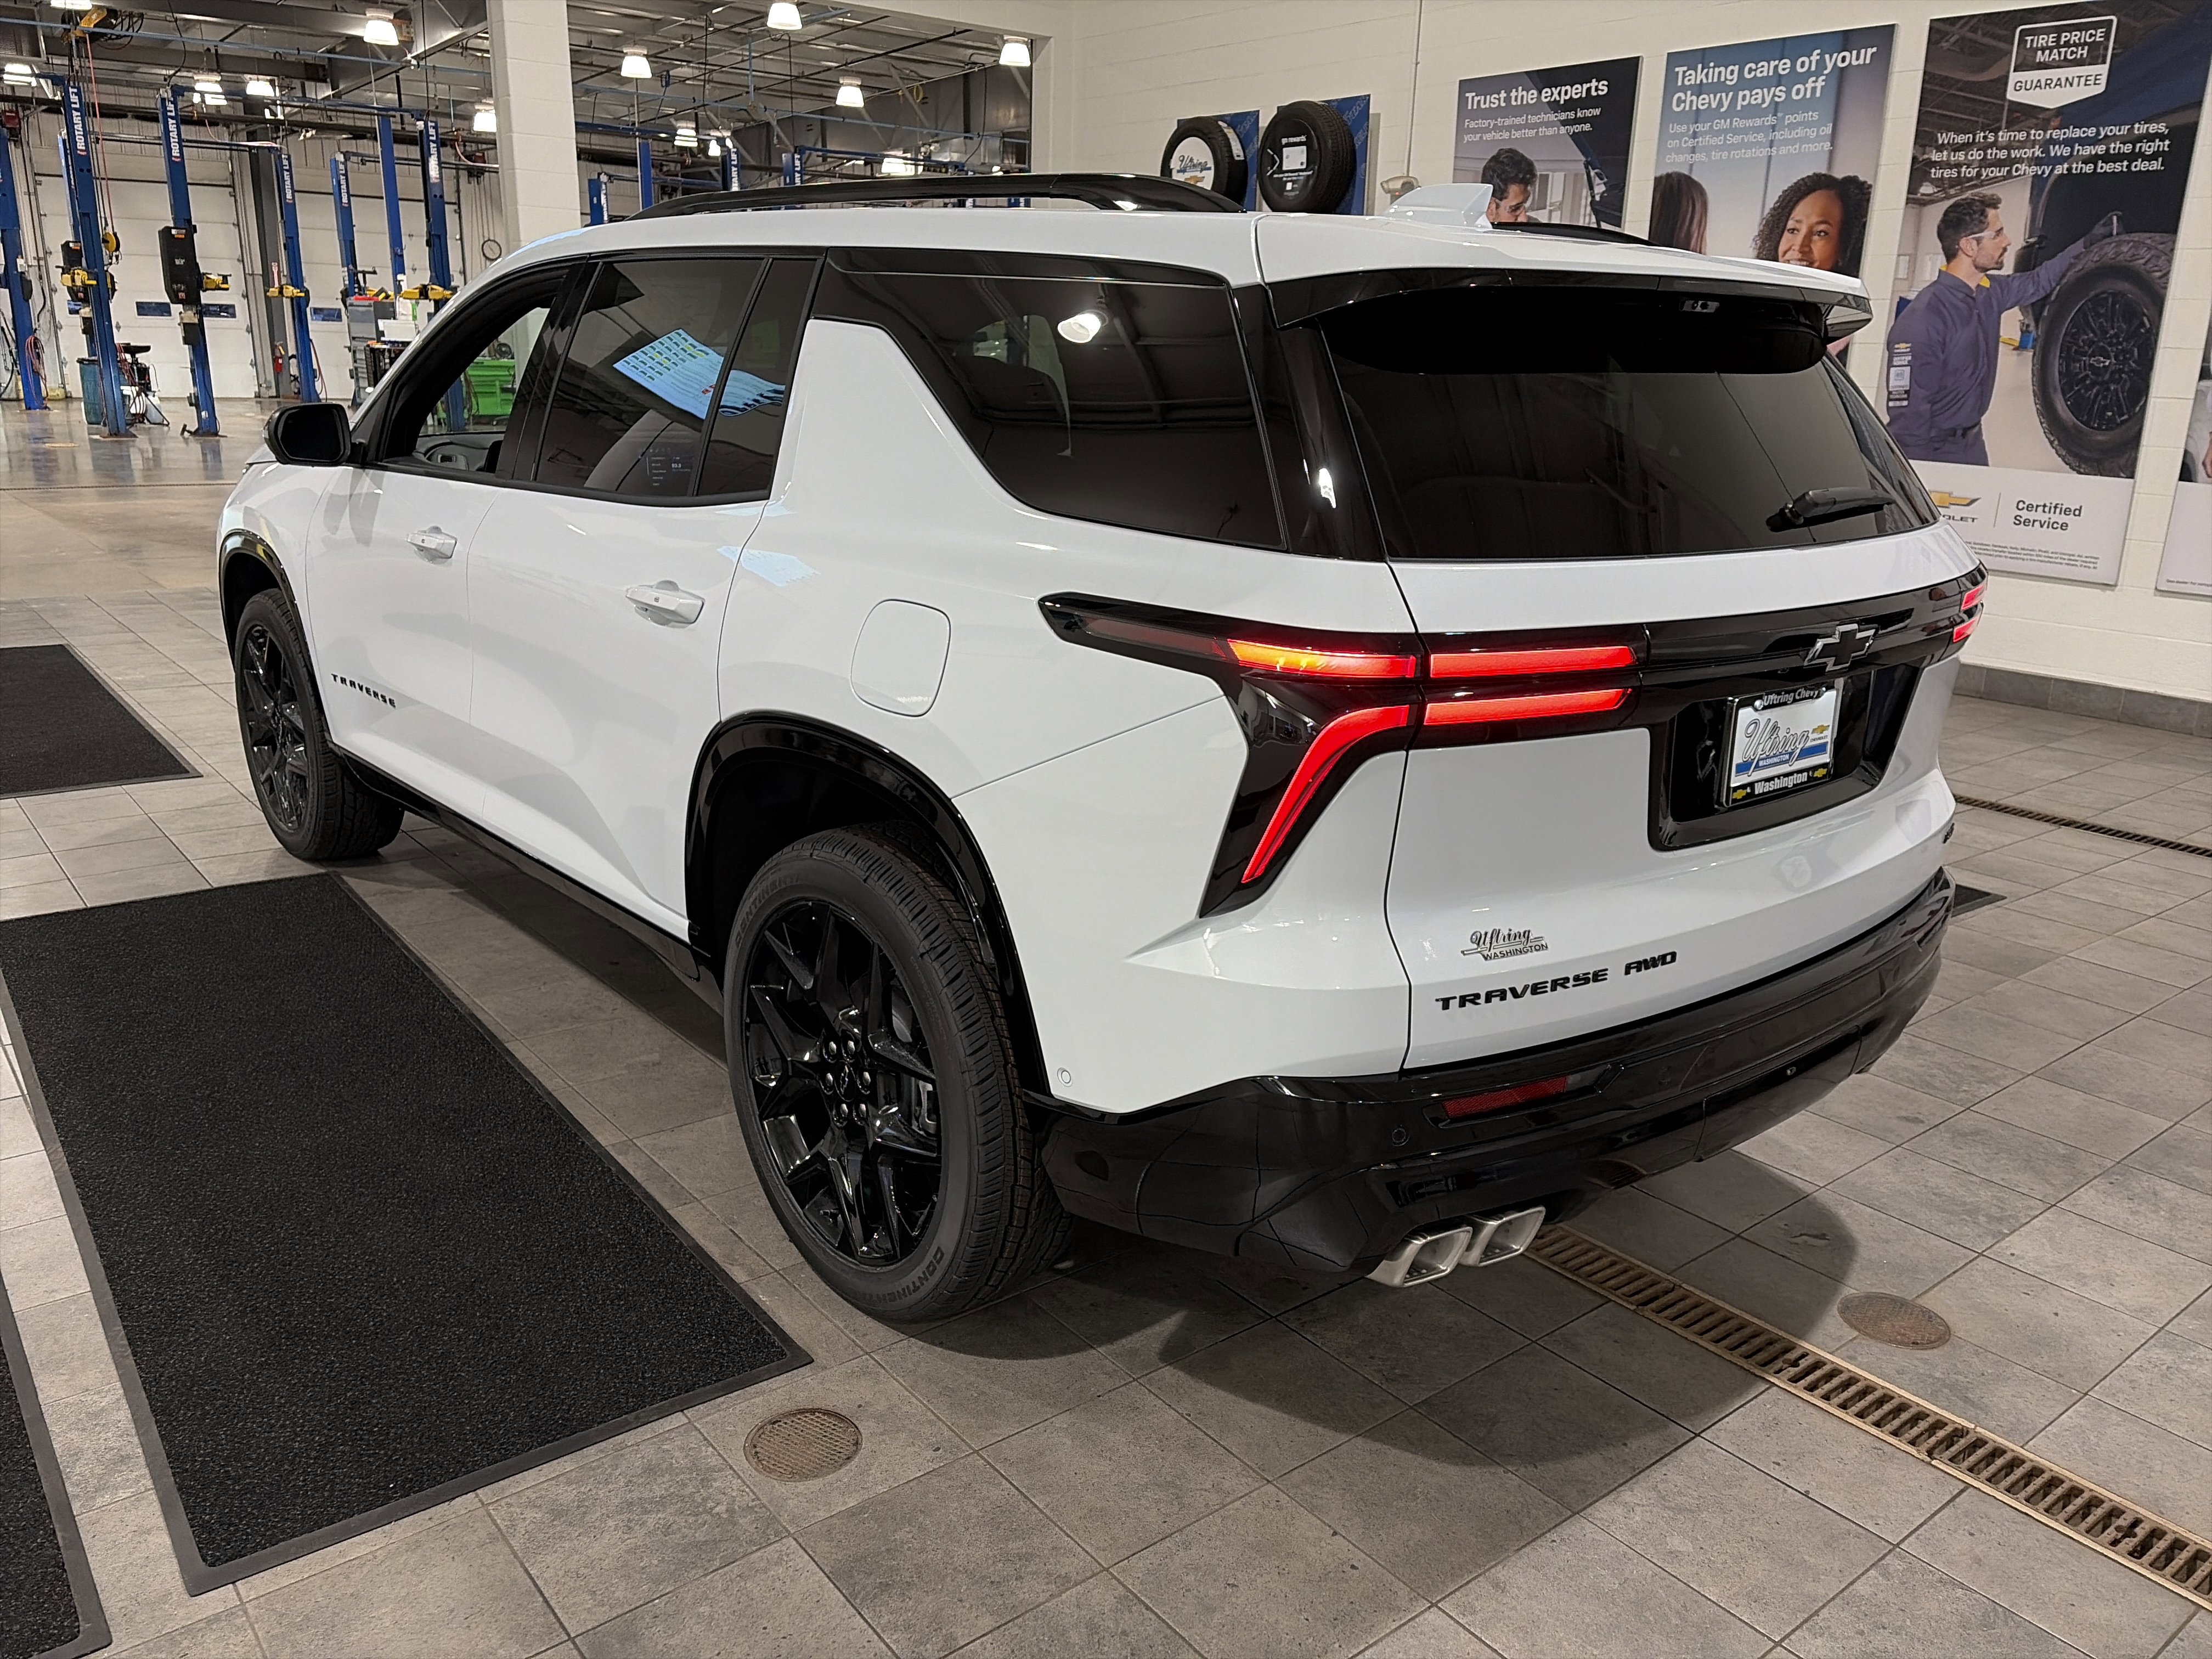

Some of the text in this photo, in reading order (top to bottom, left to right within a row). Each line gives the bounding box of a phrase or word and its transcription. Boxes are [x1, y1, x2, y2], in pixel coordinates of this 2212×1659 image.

[2024, 28, 2106, 48] TIRE PRICE
[2036, 46, 2088, 63] MATCH
[1675, 47, 1877, 86] Taking care of your
[1465, 78, 1609, 110] Trust the experts
[1672, 75, 1826, 112] Chevy pays off
[2013, 74, 2103, 92] GUARANTEE
[69, 86, 86, 150] ROTARY LIFT
[1464, 107, 1601, 128] Factory-trained technicians know
[1669, 123, 1687, 133] Use
[1689, 121, 1711, 134] your
[1713, 118, 1730, 130] GM
[1784, 111, 1819, 125] points
[168, 117, 180, 157] ROTARY
[428, 121, 436, 140] LIFT
[1463, 123, 1593, 143] your vehicle better than anyone.
[1667, 123, 1832, 148] on Certified Service, including oil
[1938, 131, 1973, 144] When
[1998, 128, 2027, 141] time
[2030, 128, 2044, 139] to
[2046, 127, 2096, 144] replace
[2098, 125, 2131, 138] your
[2134, 121, 2169, 135] tires,
[1666, 141, 1833, 163] changes, tire rotations and more.
[1932, 138, 2170, 162] let us do the work. We have the right
[1931, 157, 2165, 179] tires for your Chevy at the best deal.
[284, 170, 292, 199] ROTARY
[340, 175, 348, 203] ROTARY
[2016, 500, 2083, 517] Certified
[2013, 515, 2069, 531] Service
[331, 673, 396, 708] TRAVERSE
[1763, 688, 1819, 706] Uftring Chevy
[1742, 718, 1810, 776] Uftring
[1759, 754, 1789, 766] WASHINGTON
[1754, 772, 1808, 794] Washington
[1470, 928, 1532, 951] Uftring
[1482, 943, 1549, 961] WASHINGTON
[1435, 951, 1677, 1011] TRAVERSE AWD
